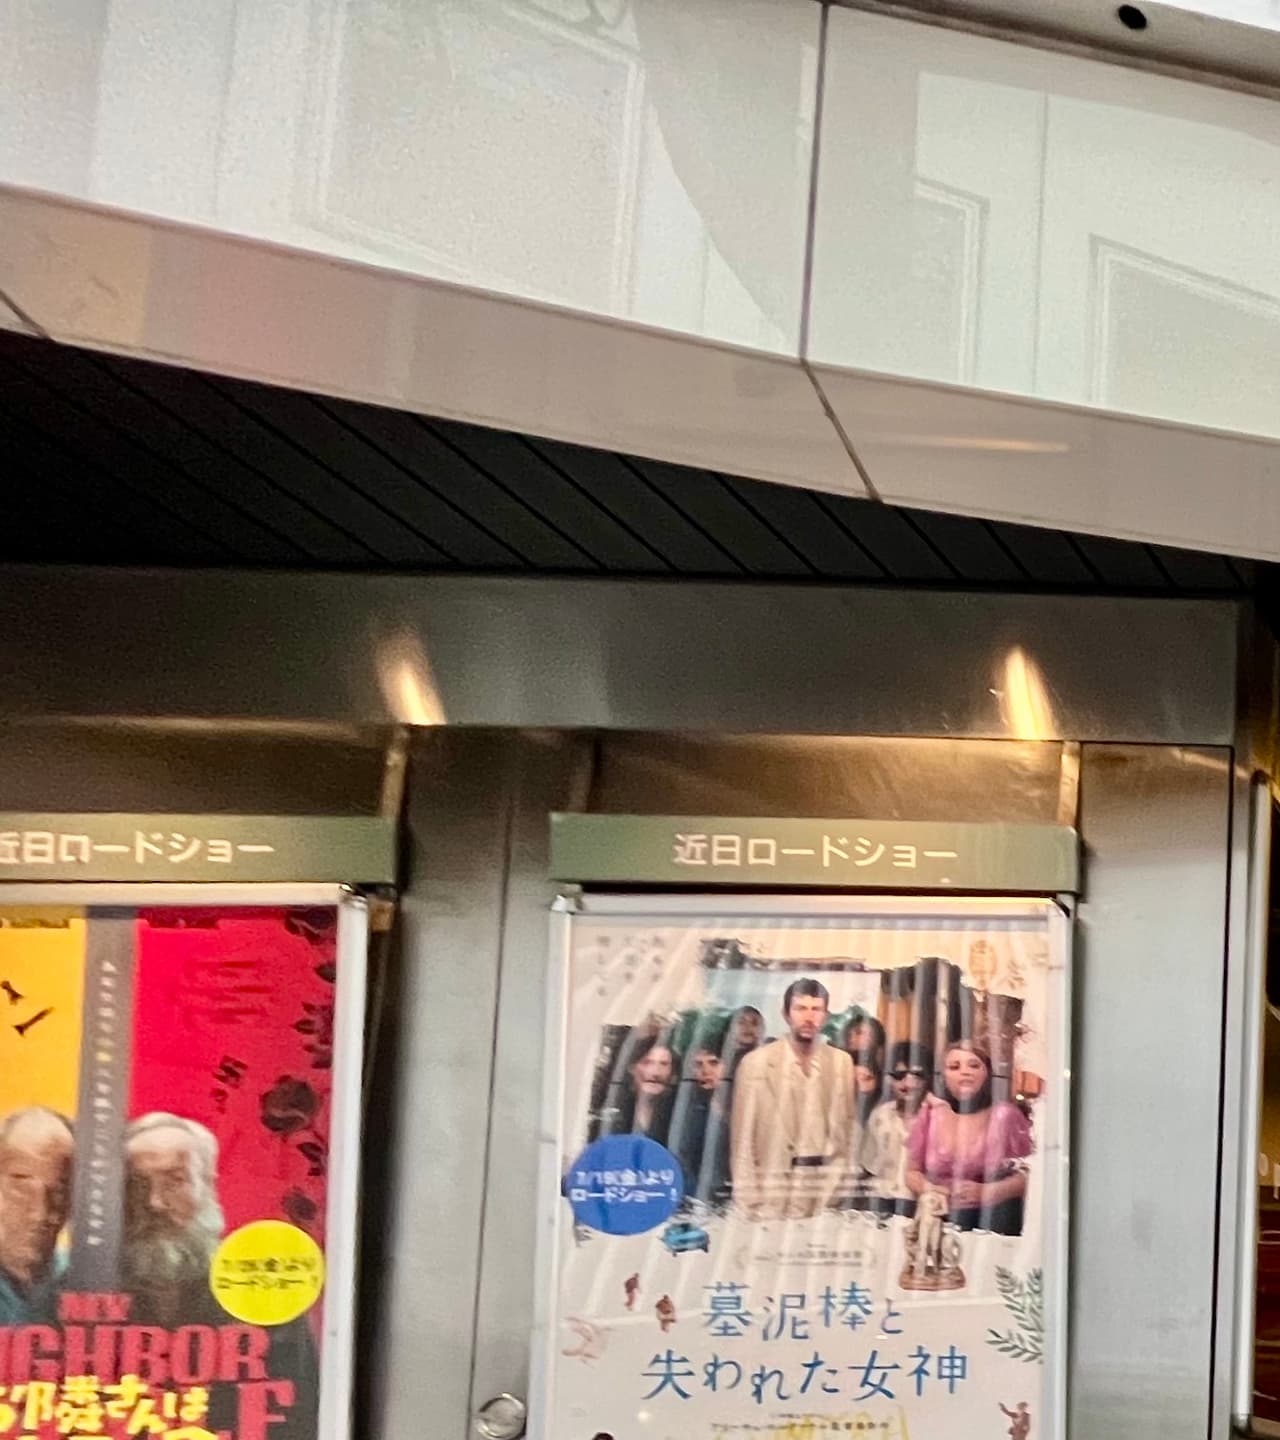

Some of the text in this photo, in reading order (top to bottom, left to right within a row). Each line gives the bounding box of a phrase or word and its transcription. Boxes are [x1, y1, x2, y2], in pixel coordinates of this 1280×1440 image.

[672, 833, 958, 870] 近日ロードショー
[702, 1281, 905, 1341] 墓泥棒と
[641, 1345, 969, 1404] 失われた女神
